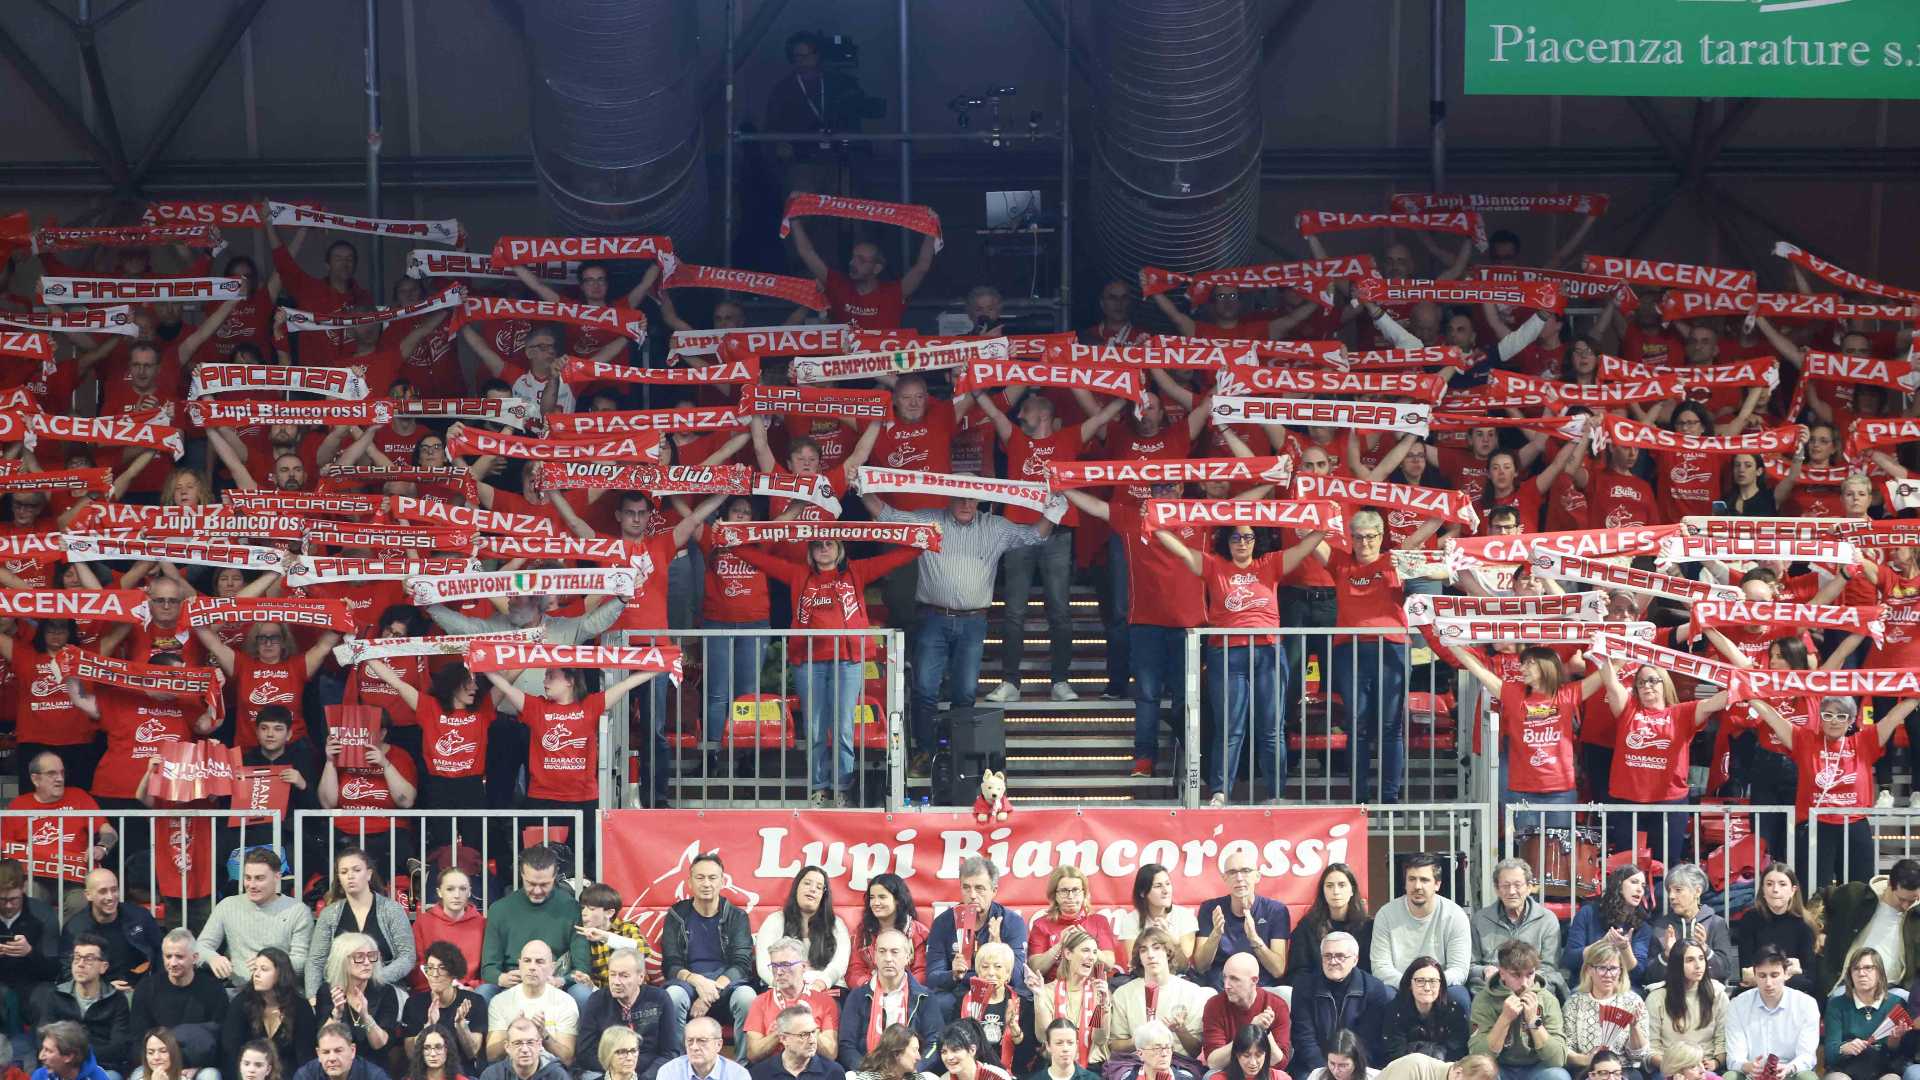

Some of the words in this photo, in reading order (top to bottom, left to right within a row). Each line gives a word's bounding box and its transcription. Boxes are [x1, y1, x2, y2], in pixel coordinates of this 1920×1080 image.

[1489, 24, 1684, 64] Piacenza
[1699, 34, 1870, 67] tarature
[221, 201, 261, 223] SA
[818, 193, 896, 216] Piacenza
[510, 236, 657, 260] PIACENZA
[698, 266, 777, 288] Piacenza
[1604, 258, 1751, 291] PIACENZA
[72, 281, 213, 299] PIACENZA
[464, 297, 619, 327] PIACENZA
[821, 353, 893, 377] CAMPIONI
[919, 346, 982, 367] D'ITALIA
[1071, 345, 1227, 365] PIACENZA
[200, 365, 348, 394] PIACENZA
[593, 361, 752, 381] PIACENZA
[973, 363, 1133, 393] PIACENZA
[1251, 368, 1316, 391] GAS
[1321, 371, 1417, 392] SALES
[1602, 355, 1756, 383] PIACENZA
[1507, 376, 1665, 402] PIACENZA
[210, 402, 251, 420] Lupi
[257, 401, 367, 419] Biancorossi
[575, 410, 738, 435] PIACENZA
[1243, 401, 1397, 426] PIACENZA
[477, 435, 638, 459] PIACENZA
[1614, 421, 1676, 446] GAS
[1681, 431, 1778, 451] SALES
[565, 462, 625, 479] Volley
[668, 465, 714, 484] Club
[1084, 461, 1252, 482] PIACENZA
[865, 470, 916, 486] Lupi
[922, 472, 1048, 504] Biancorossi
[1296, 475, 1451, 517] PIACENZA
[153, 512, 197, 531] Lupi
[203, 511, 305, 531] Biancoross
[398, 495, 554, 536] PIACENZA
[1156, 501, 1320, 525] PIACENZA
[747, 525, 790, 542] Lupi
[796, 524, 910, 541] Biancorossi
[1563, 530, 1656, 557] SALES
[98, 537, 249, 565] PIACENZA
[475, 536, 627, 558] PIACENZA
[1683, 537, 1839, 558] PIACENZA
[314, 558, 469, 578] PIACENZA
[1560, 554, 1712, 601] PIACENZA
[436, 577, 512, 598] CAMPIONI
[540, 573, 606, 592] D'ITALIA
[1496, 571, 1513, 592] 22
[1432, 595, 1583, 617] PIACENZA
[1696, 601, 1861, 627] PIACENZA
[1470, 621, 1627, 640] PIACENZA
[494, 644, 665, 668] PIACENZA
[1749, 671, 1920, 693] PIACENZA
[1522, 728, 1562, 744] Bulla
[753, 827, 918, 892] Lupi
[939, 823, 1352, 880] Biancorossi
